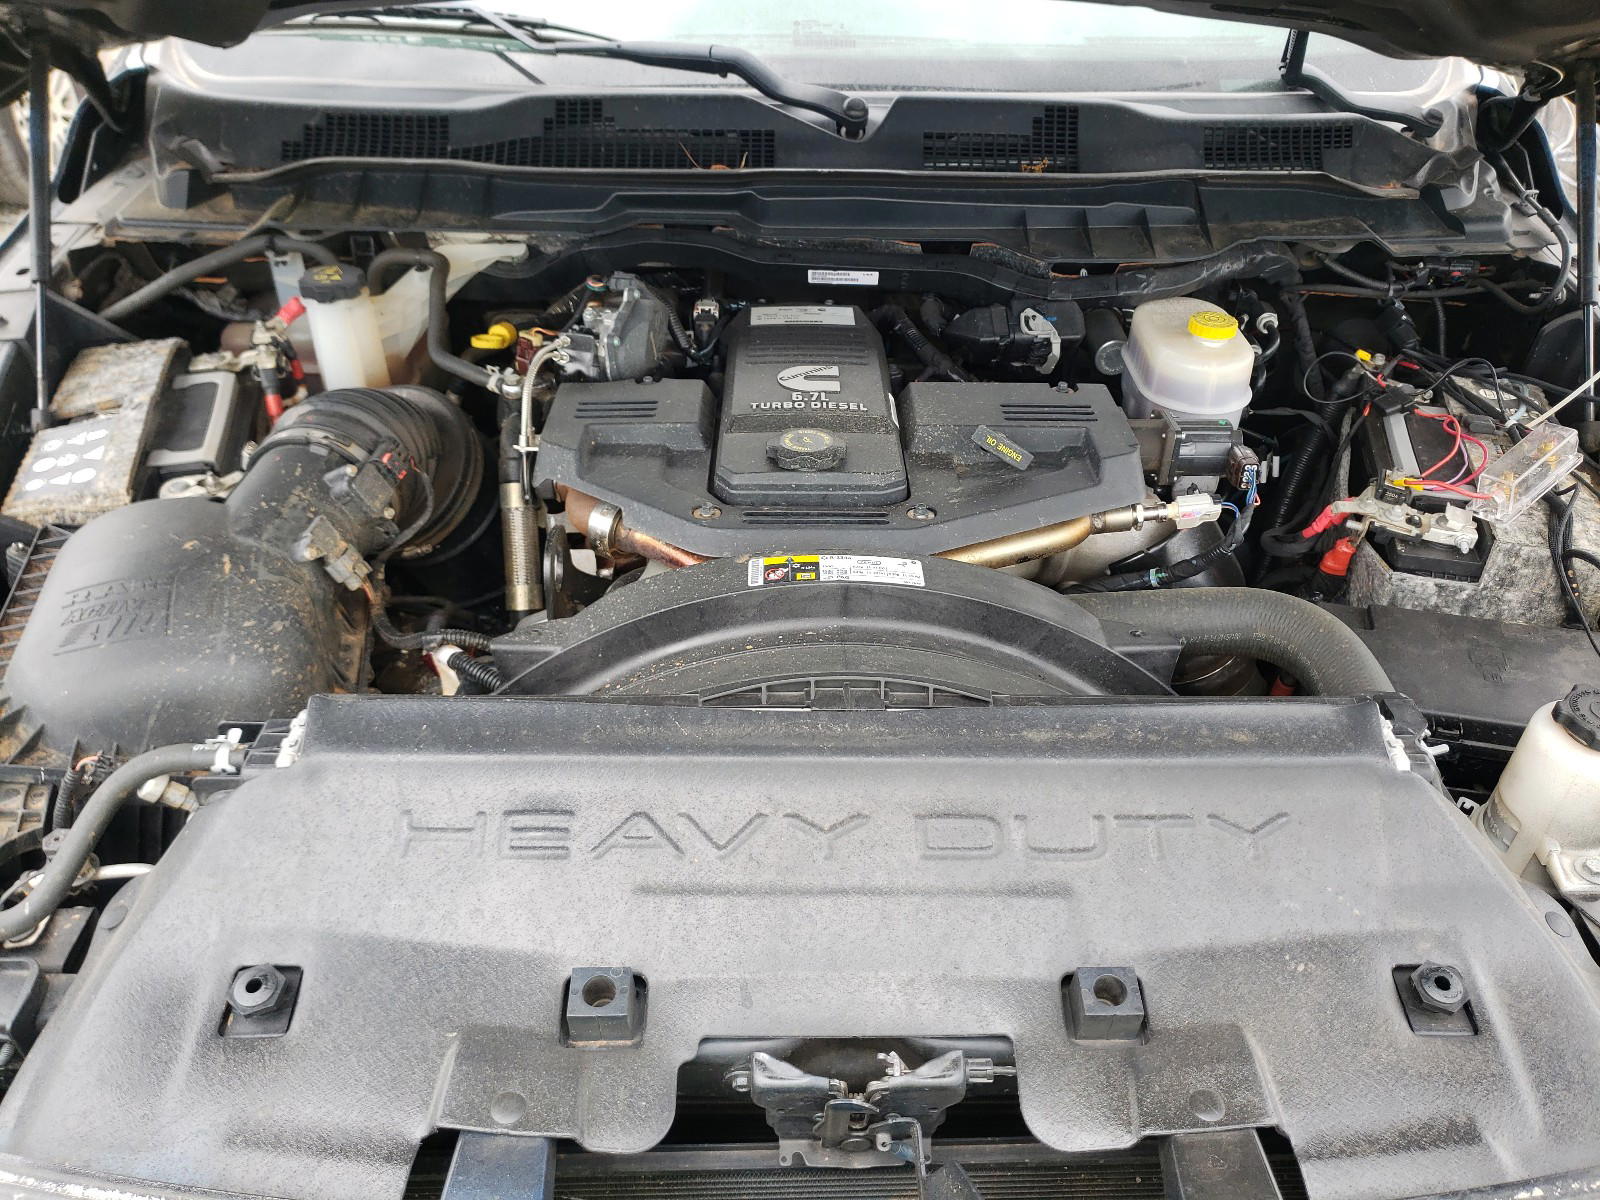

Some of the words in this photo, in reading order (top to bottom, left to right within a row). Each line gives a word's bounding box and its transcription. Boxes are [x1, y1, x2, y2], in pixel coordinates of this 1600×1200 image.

[778, 365, 834, 380] Cummins
[791, 392, 830, 401] 6.7L
[751, 402, 806, 410] TURBO
[810, 402, 868, 411] DIESEL
[985, 434, 997, 446] OIL
[996, 443, 1023, 463] ENGINE
[398, 808, 870, 860] HEAVY
[911, 812, 1291, 862] DUTY
